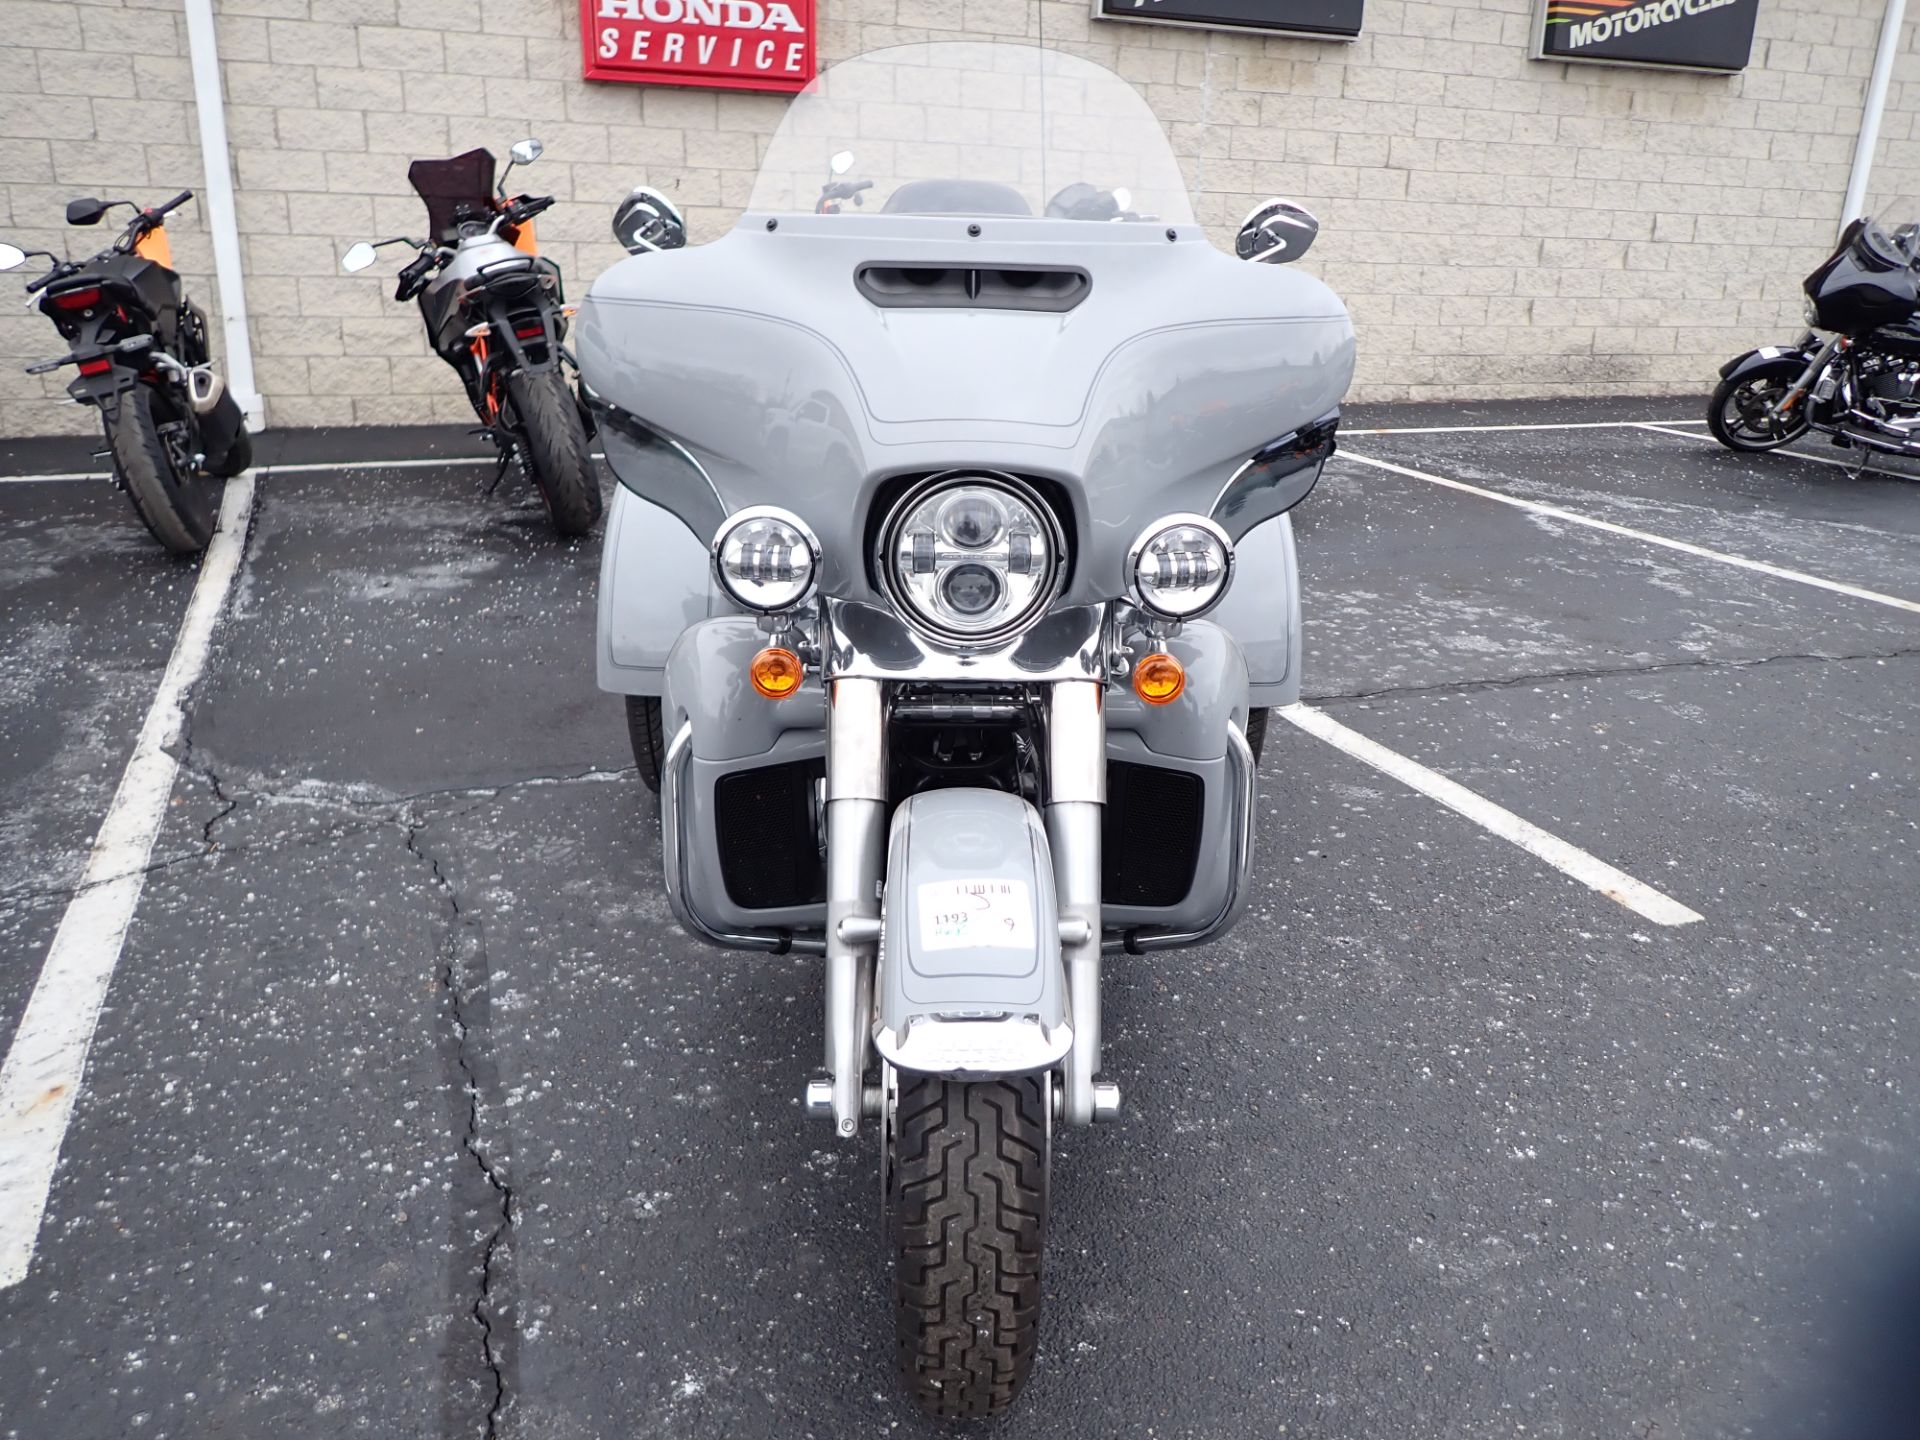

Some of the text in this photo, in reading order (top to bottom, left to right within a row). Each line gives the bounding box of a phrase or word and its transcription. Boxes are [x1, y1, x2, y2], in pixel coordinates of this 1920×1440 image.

[598, 0, 805, 33] HONDA
[1569, 0, 1738, 49] MOTORCYCL
[599, 28, 805, 72] SERVICE
